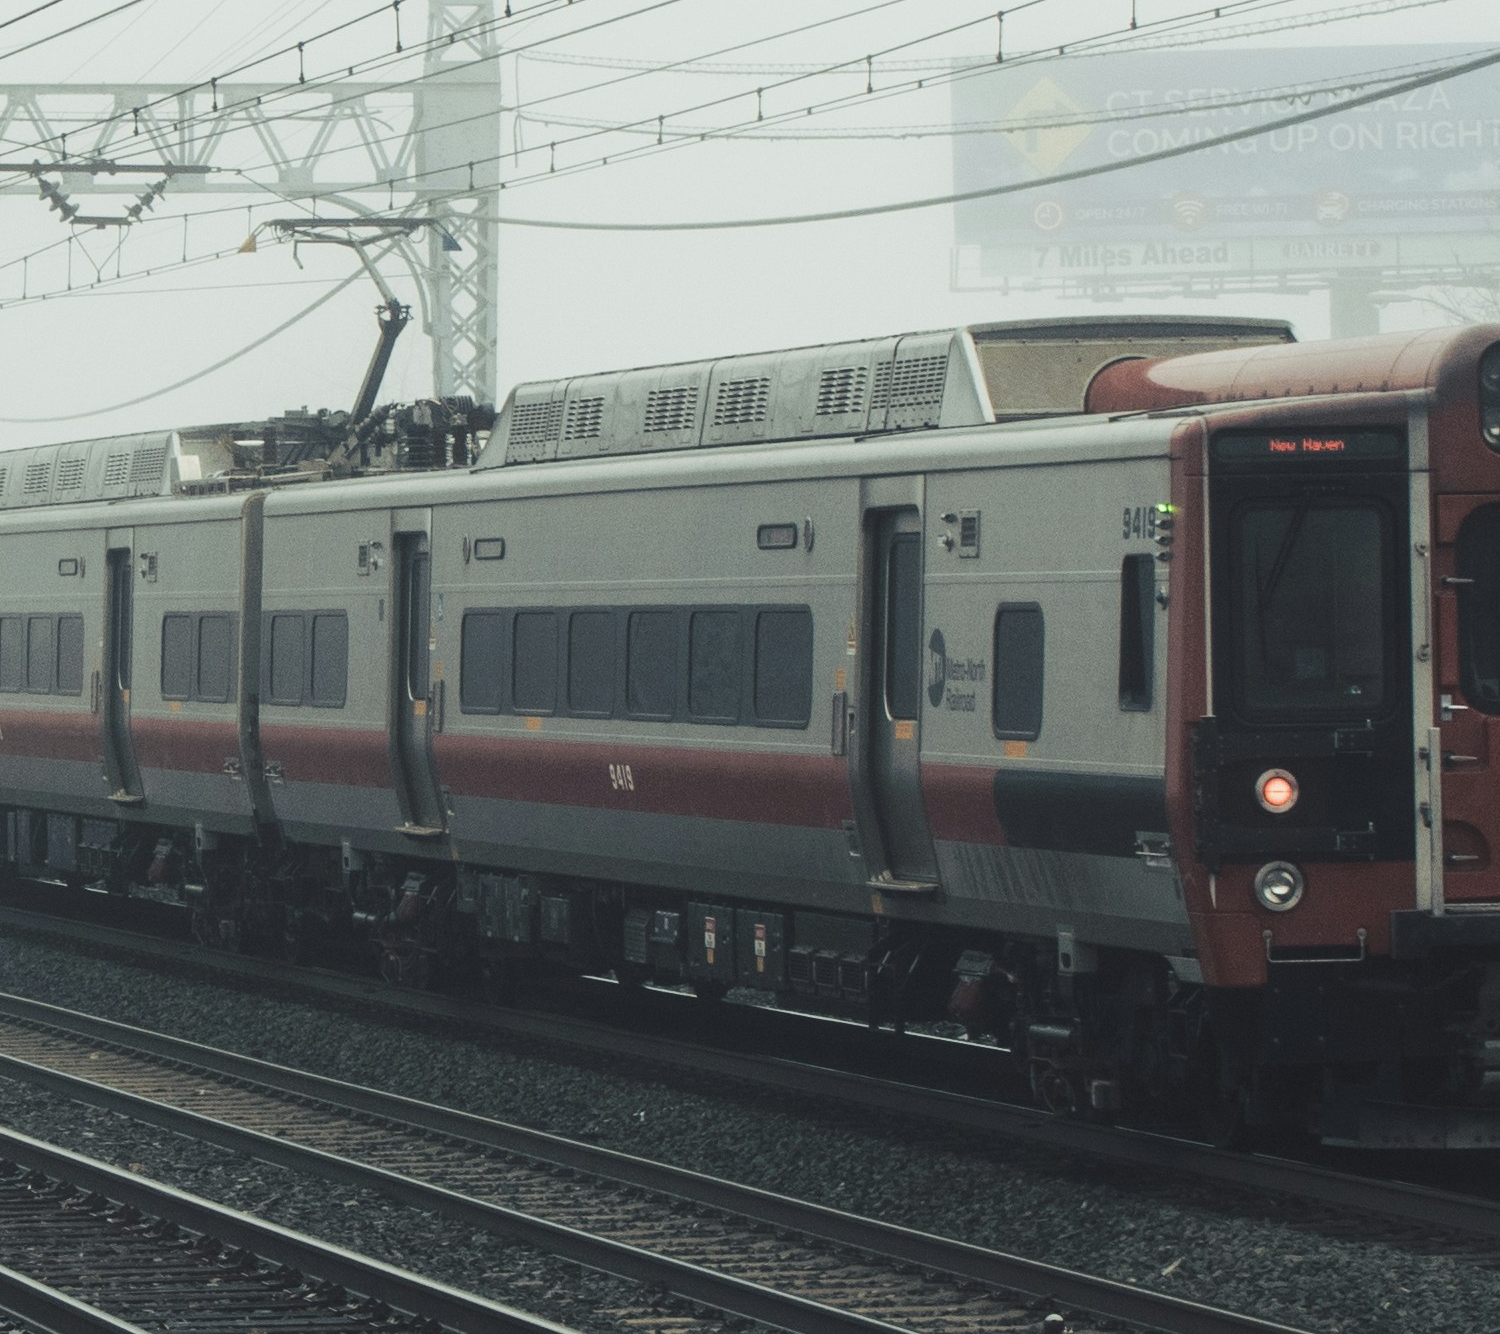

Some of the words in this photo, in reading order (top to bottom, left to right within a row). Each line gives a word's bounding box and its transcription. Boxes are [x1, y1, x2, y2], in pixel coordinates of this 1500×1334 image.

[1105, 90, 1153, 118] CT
[1163, 85, 1313, 117] SERVICE
[1327, 83, 1452, 114] PLAZA
[1107, 126, 1258, 157] COMING
[1268, 124, 1319, 152] UP
[1328, 123, 1383, 151] ON
[1075, 208, 1112, 220] OPEN
[1215, 205, 1249, 217] FREE
[1358, 198, 1429, 212] CHARGING
[1431, 196, 1497, 210] STATIONS
[1035, 248, 1050, 267] 7
[1060, 243, 1132, 268] Miles
[1140, 242, 1229, 265] Ahead
[1288, 242, 1373, 258] BARRETT
[1270, 439, 1296, 452] New
[1303, 438, 1345, 452] Haven
[1122, 506, 1156, 540] 9419
[608, 763, 635, 791] 9419
